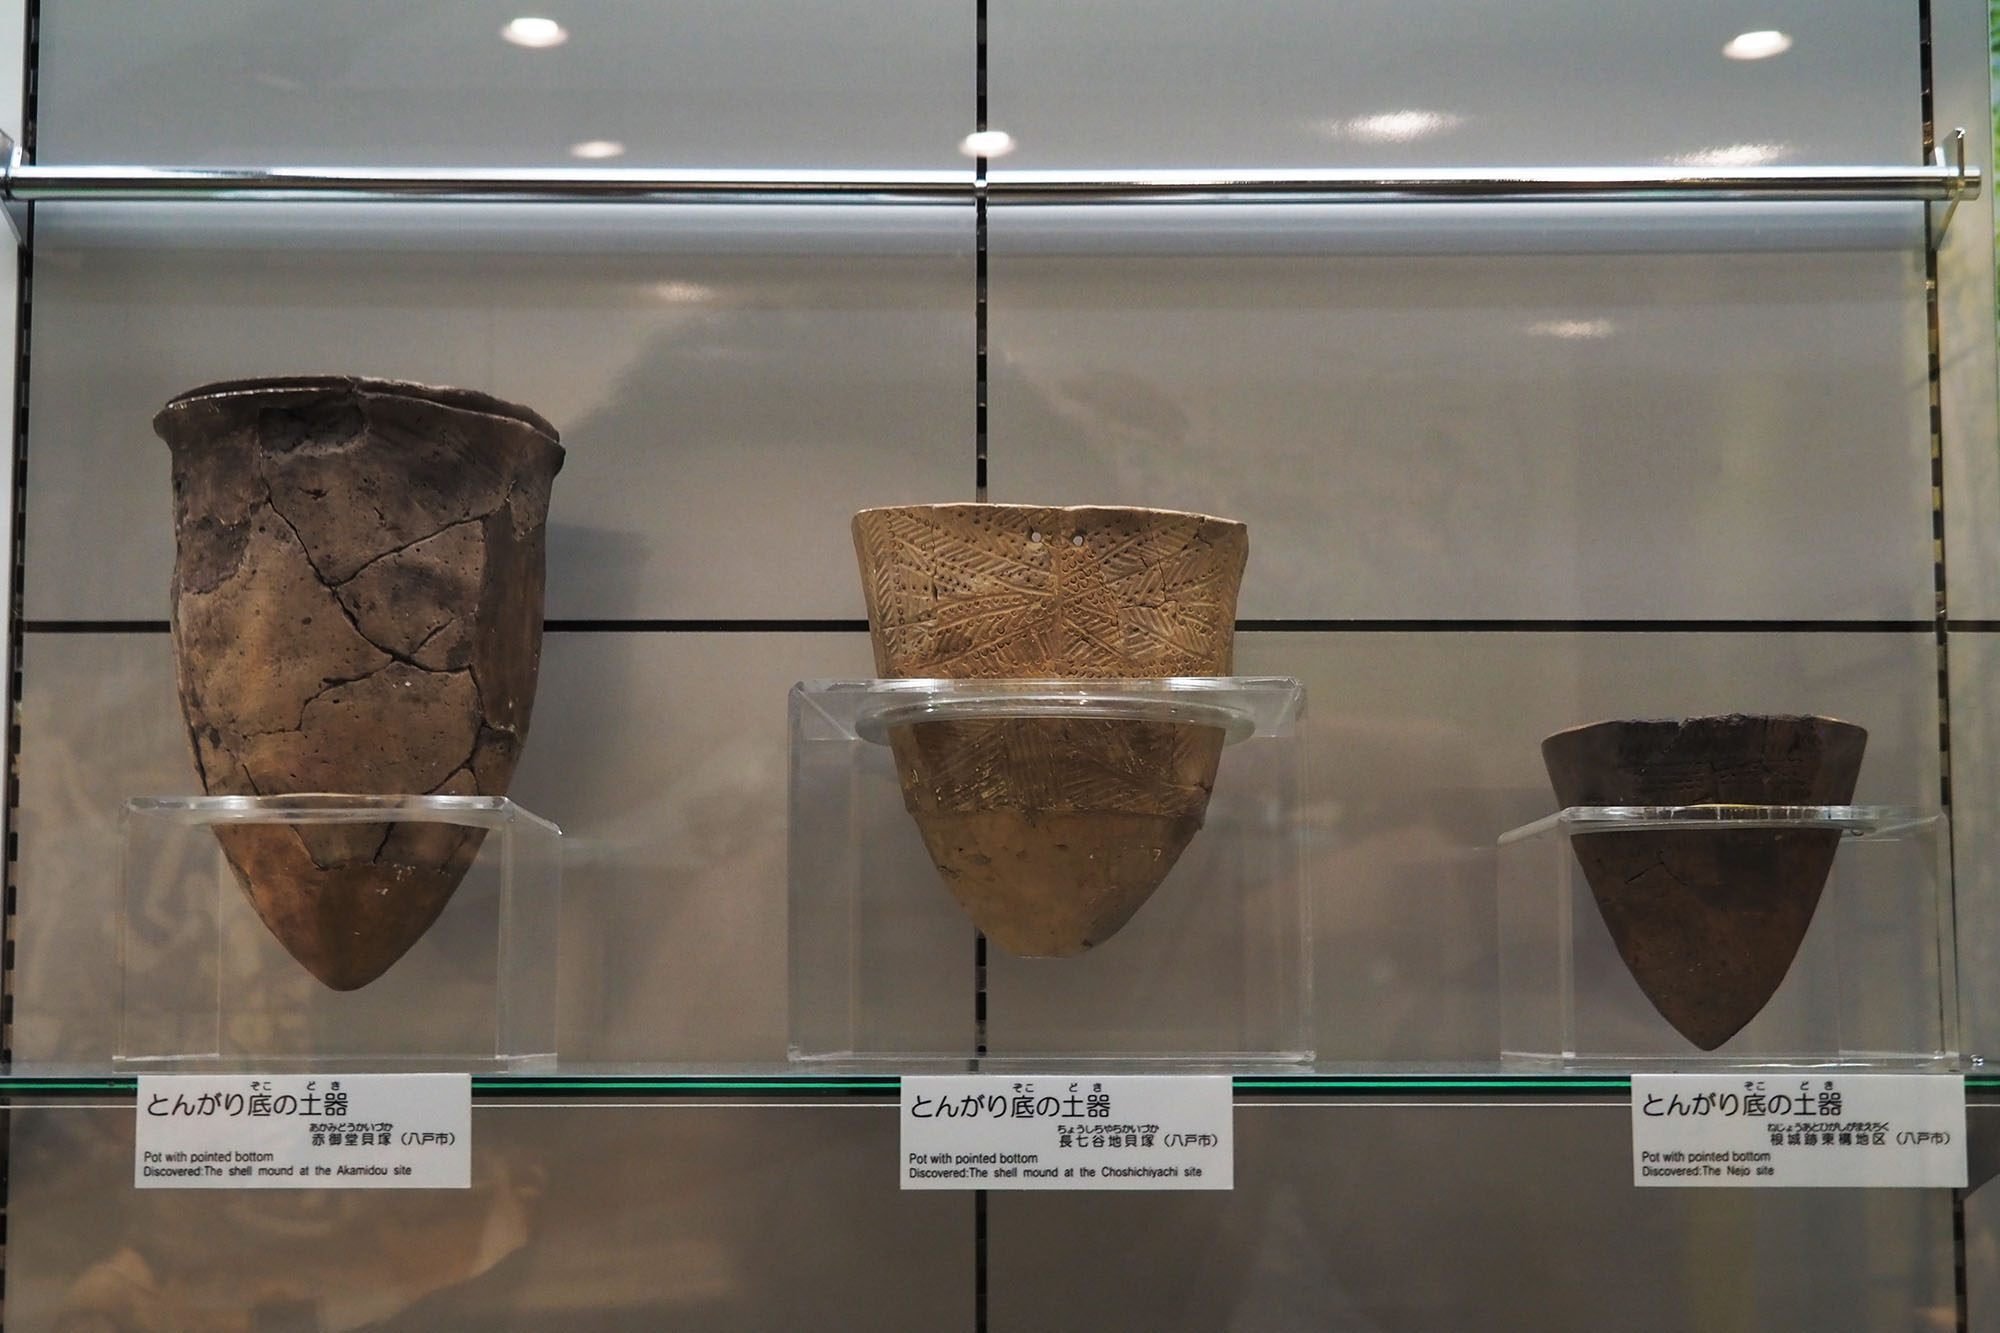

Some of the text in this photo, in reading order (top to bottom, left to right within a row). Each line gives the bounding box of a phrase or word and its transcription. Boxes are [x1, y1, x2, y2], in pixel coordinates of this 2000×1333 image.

[147, 1092, 349, 1117] とんがり底の土器
[911, 1094, 1111, 1119] とんがり底の土器
[1642, 1092, 1843, 1117] とんがり底の土器
[143, 1151, 274, 1163] Pot with pointed bottom
[908, 1153, 1039, 1165] Pot with pointed bottom
[1641, 1151, 1772, 1163] Pot with pointed bottom
[143, 1165, 413, 1175] Discovered:The shell mound at the Akamidou site
[908, 1167, 1203, 1179] Discovered:The shell mound at the Choshichiyachi site
[1641, 1165, 1776, 1177] Discovered:The Nejo site
